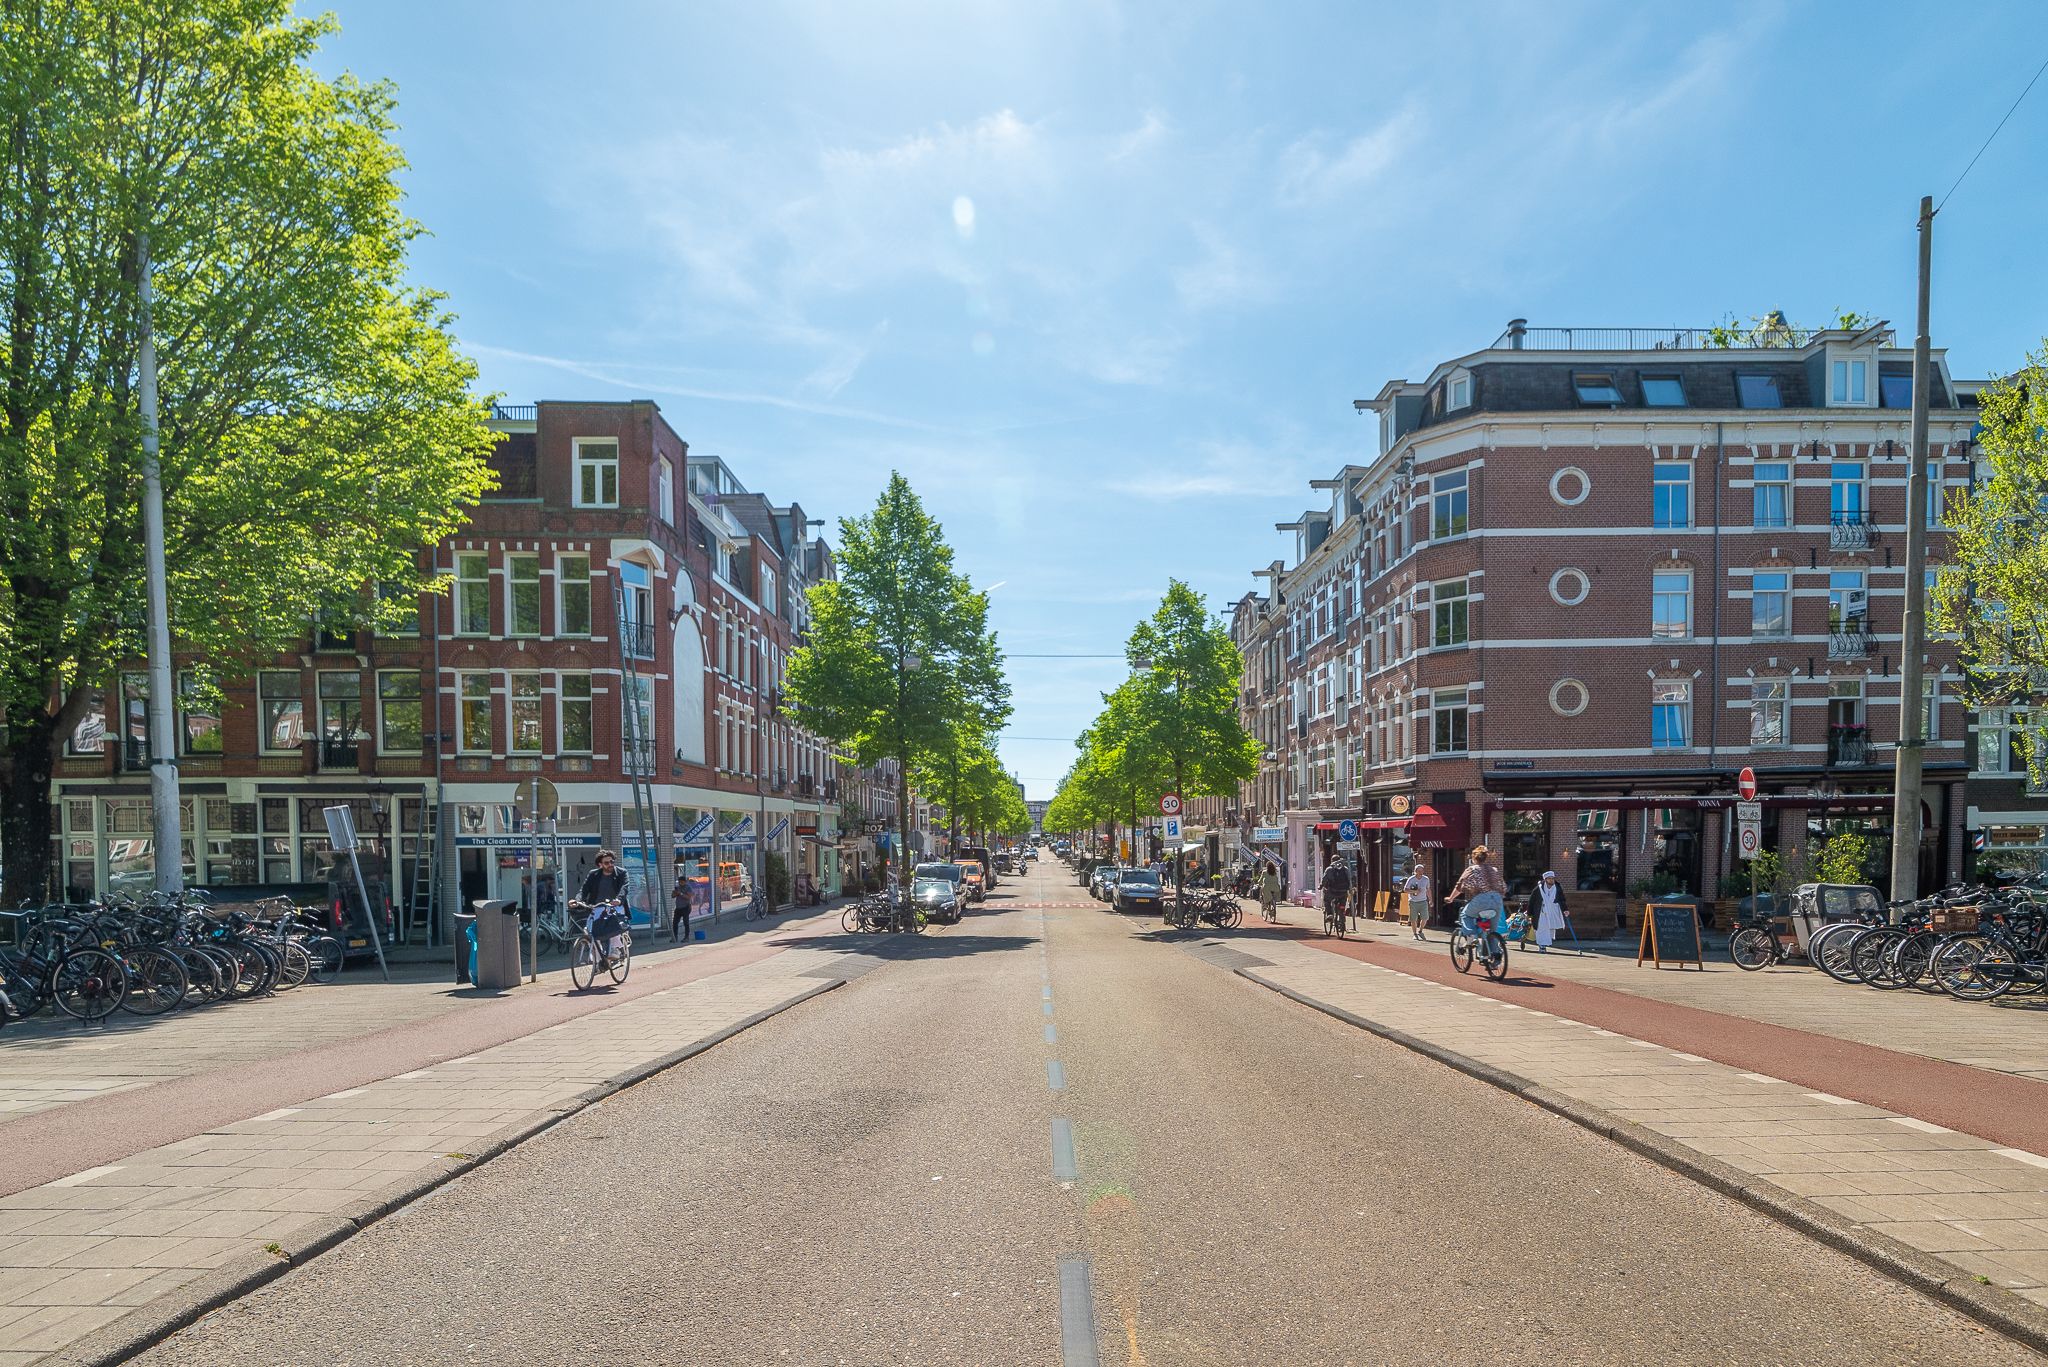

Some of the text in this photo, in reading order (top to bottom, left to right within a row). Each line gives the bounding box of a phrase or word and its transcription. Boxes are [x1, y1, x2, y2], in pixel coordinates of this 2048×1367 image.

[1164, 800, 1178, 808] 30
[684, 816, 713, 842] WASSALON
[1745, 836, 1754, 844] 30
